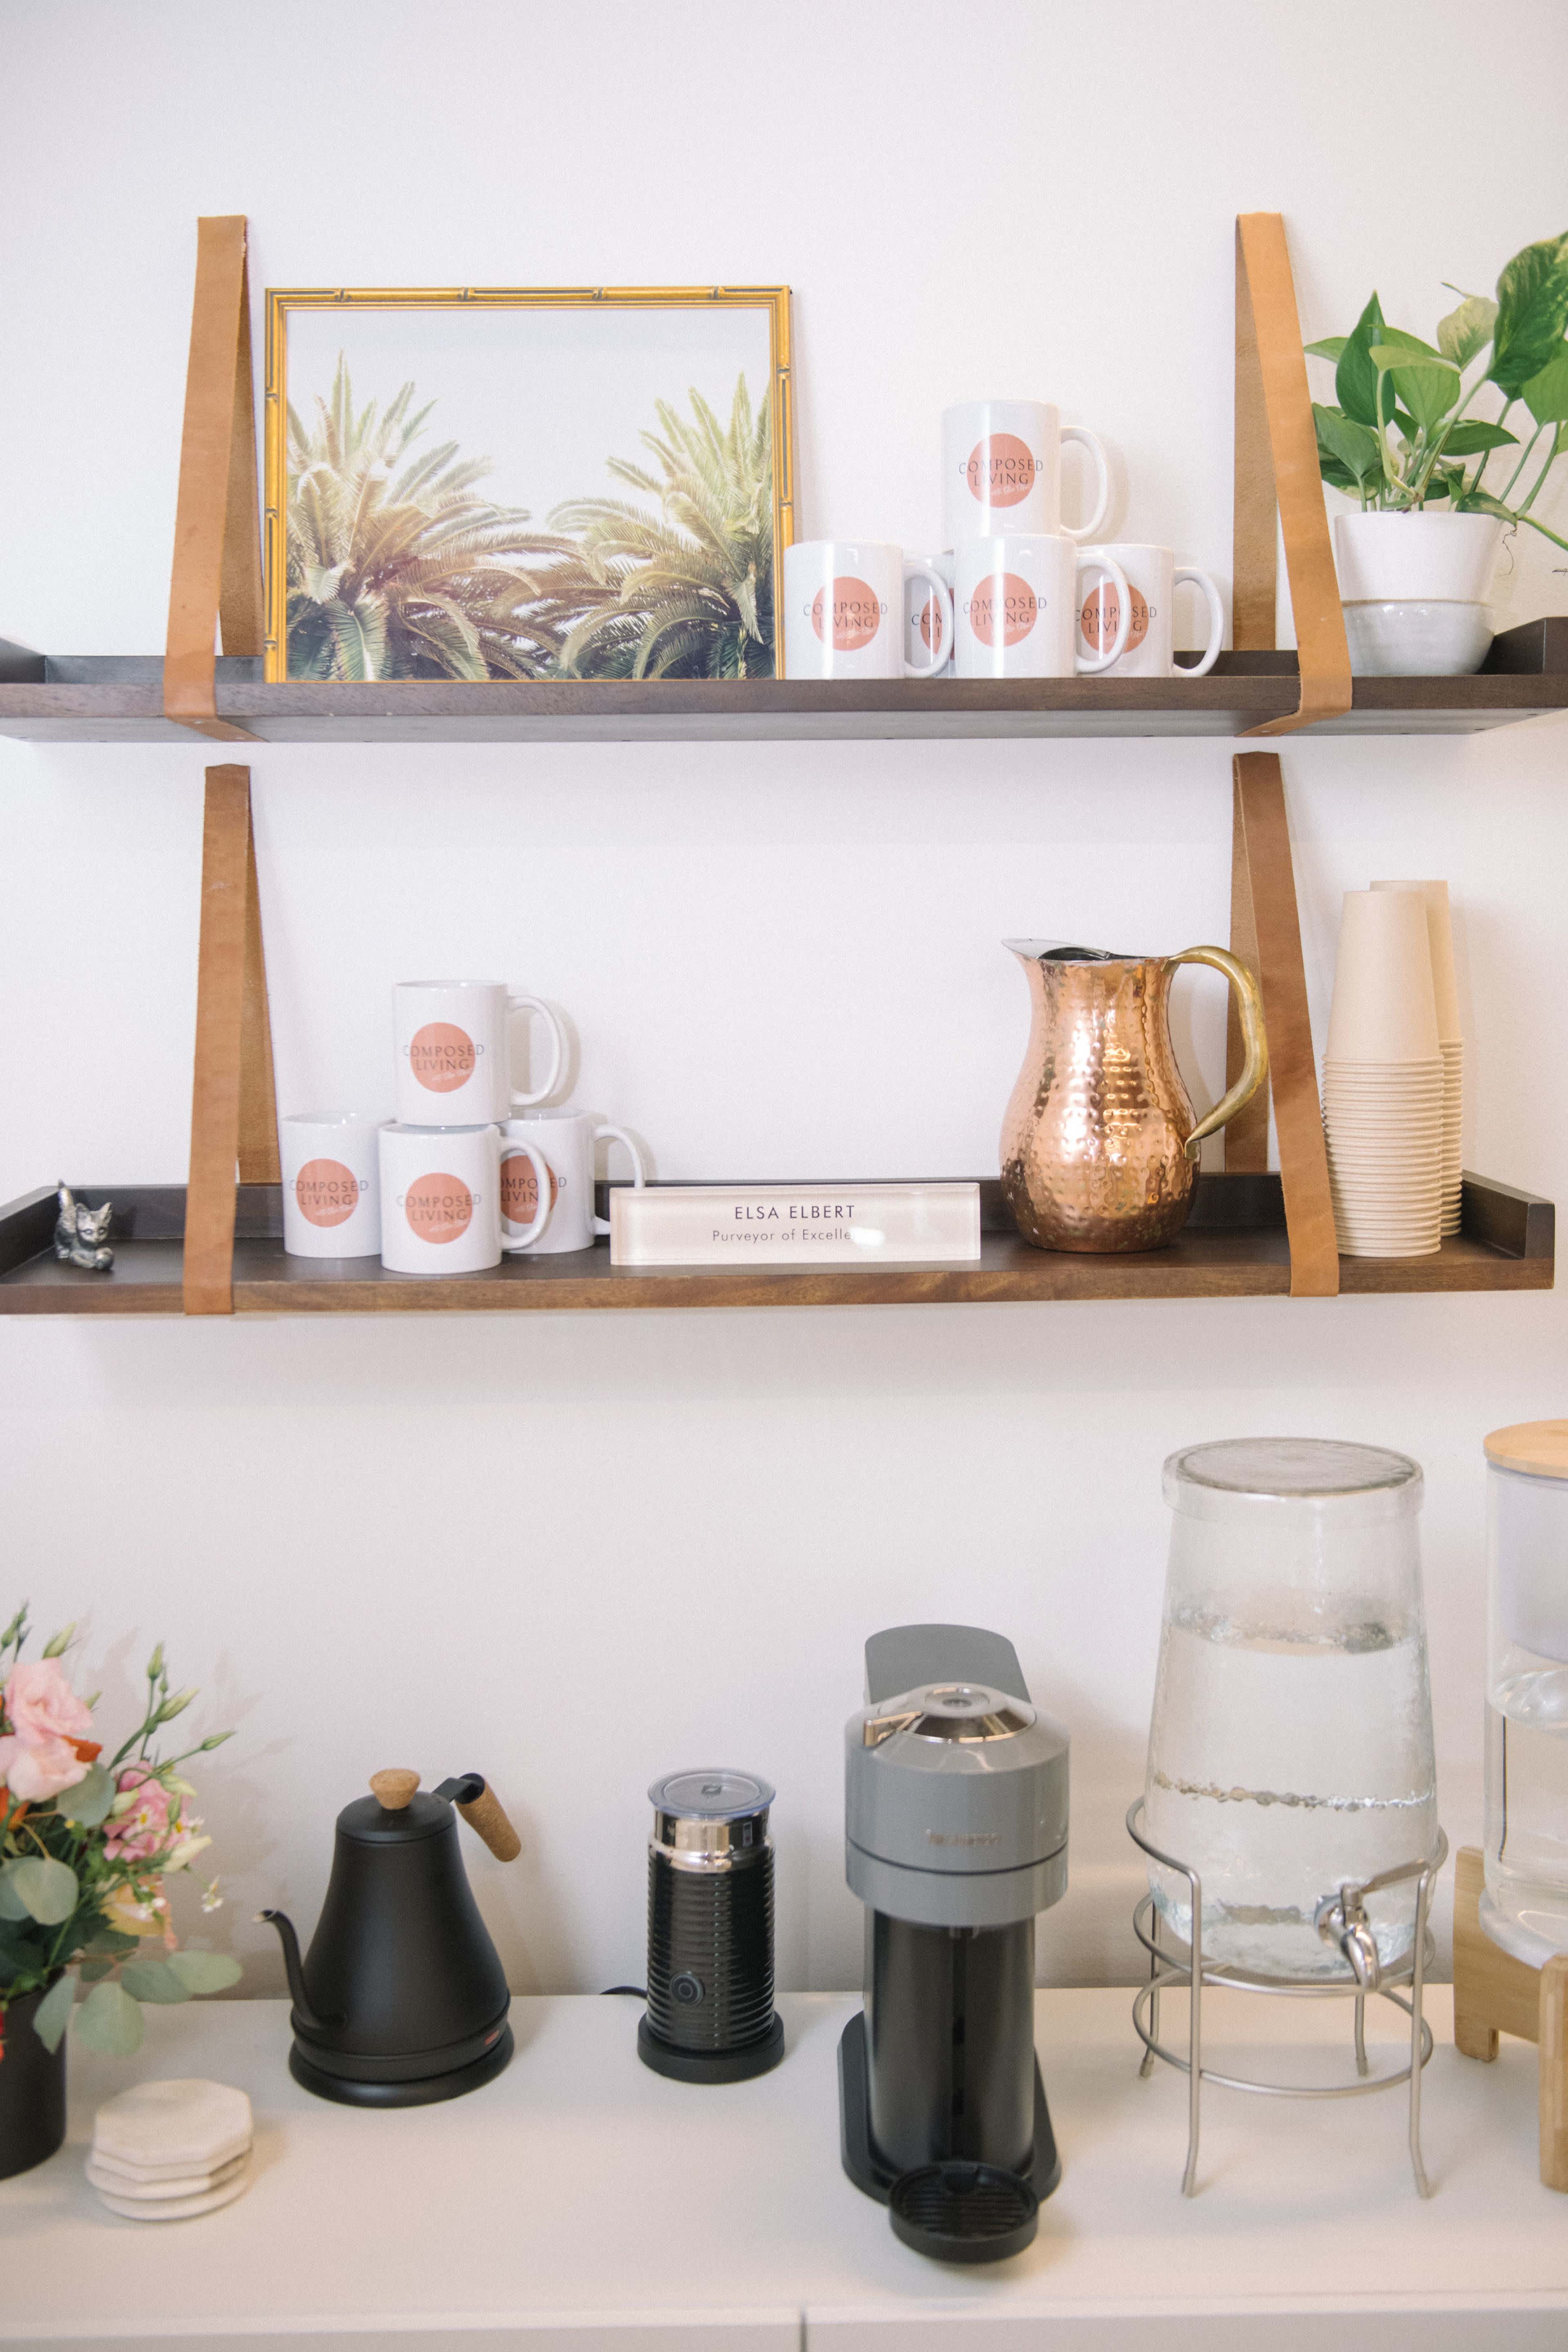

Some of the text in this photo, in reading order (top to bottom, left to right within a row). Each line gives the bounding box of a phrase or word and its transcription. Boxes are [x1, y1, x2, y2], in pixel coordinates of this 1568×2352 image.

[974, 473, 1029, 486] LVING
[963, 597, 1047, 614] COMOSED
[976, 611, 1029, 626] LIVNG
[1076, 606, 1157, 621] COMPSED
[819, 616, 873, 628] LVING
[1089, 620, 1142, 633] LIVIG
[402, 1044, 485, 1058] COMPOSED
[416, 1058, 469, 1070] LIVING
[289, 1180, 369, 1193] COMPOSED
[301, 1194, 353, 1205] LIVING
[396, 1194, 482, 1208] COMPOSED
[501, 1191, 539, 1202] LIVIN
[412, 1209, 466, 1221] LIVING
[735, 1205, 855, 1219] ELSA ELBERT
[713, 1228, 851, 1244] Purveyor of Excelle
